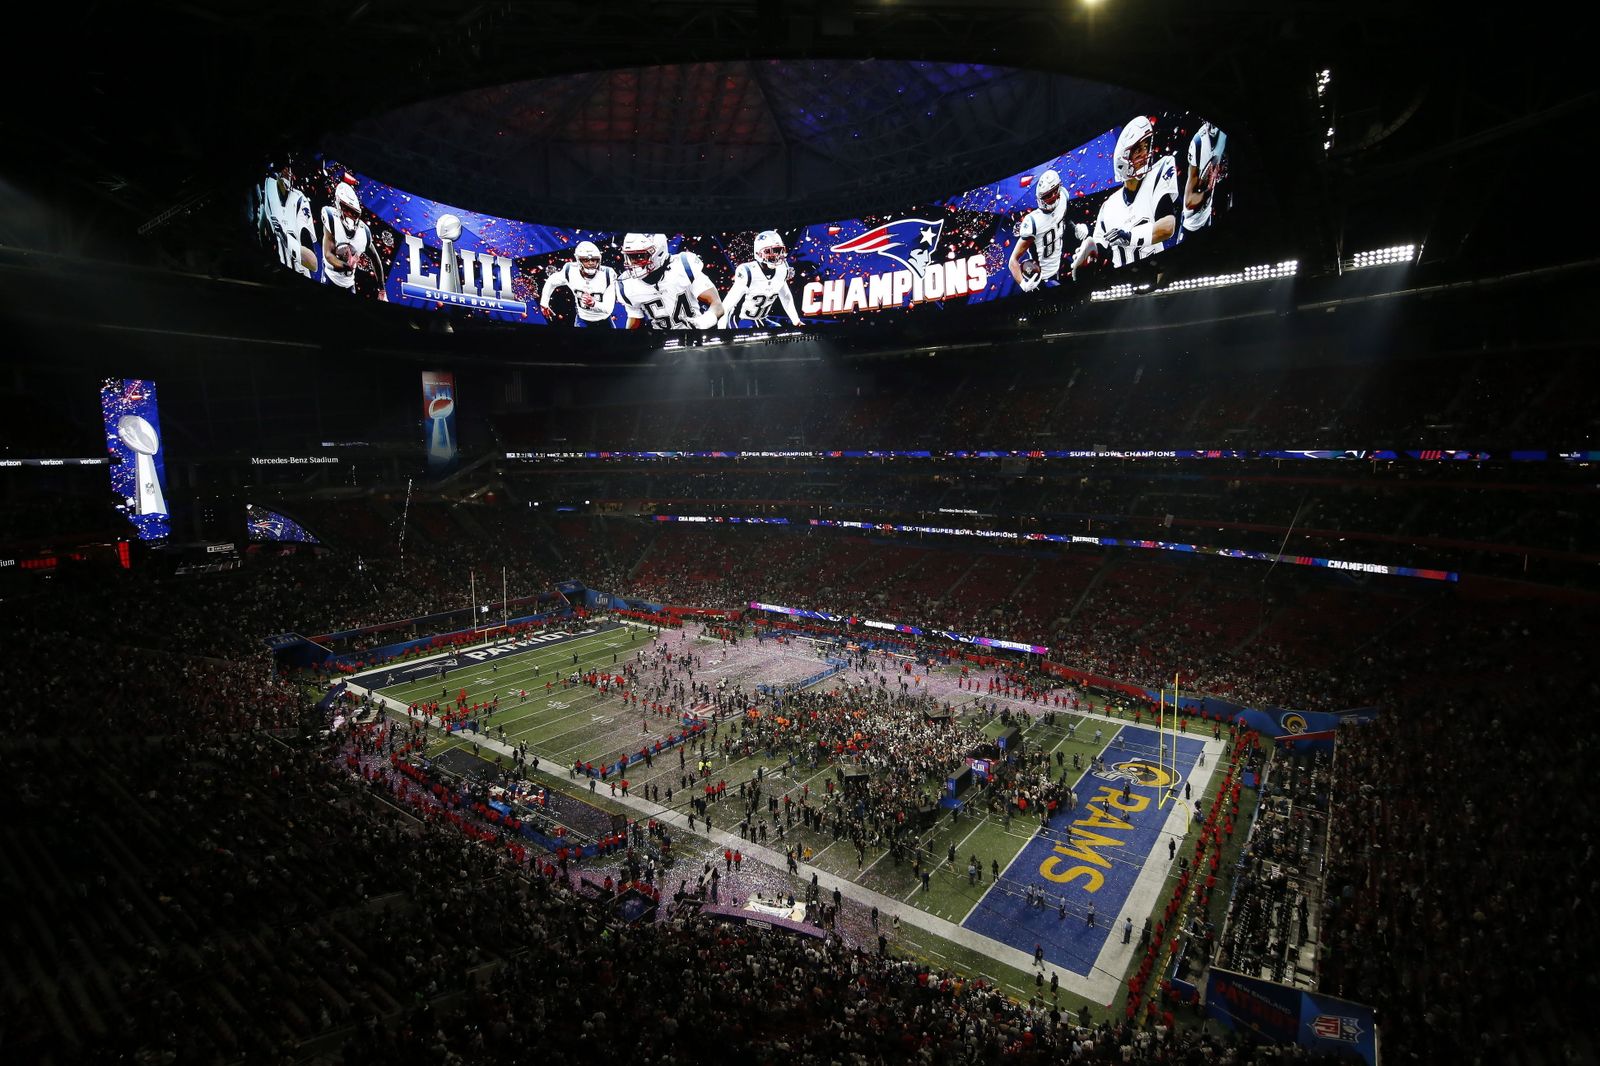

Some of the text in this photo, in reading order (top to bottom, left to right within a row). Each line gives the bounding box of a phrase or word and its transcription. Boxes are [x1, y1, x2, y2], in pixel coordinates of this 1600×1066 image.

[801, 253, 988, 316] CHAMPIONS
[425, 290, 504, 309] SUPER BOWL
[251, 456, 339, 464] Mercedes-Benz Stadium
[902, 525, 1019, 539] SIX-TIME SUPER BOWL CHAMPIONS
[1072, 535, 1099, 545] PATRIOTS
[1327, 559, 1389, 574] CHAMPIONS
[1039, 785, 1152, 894] RAMS
